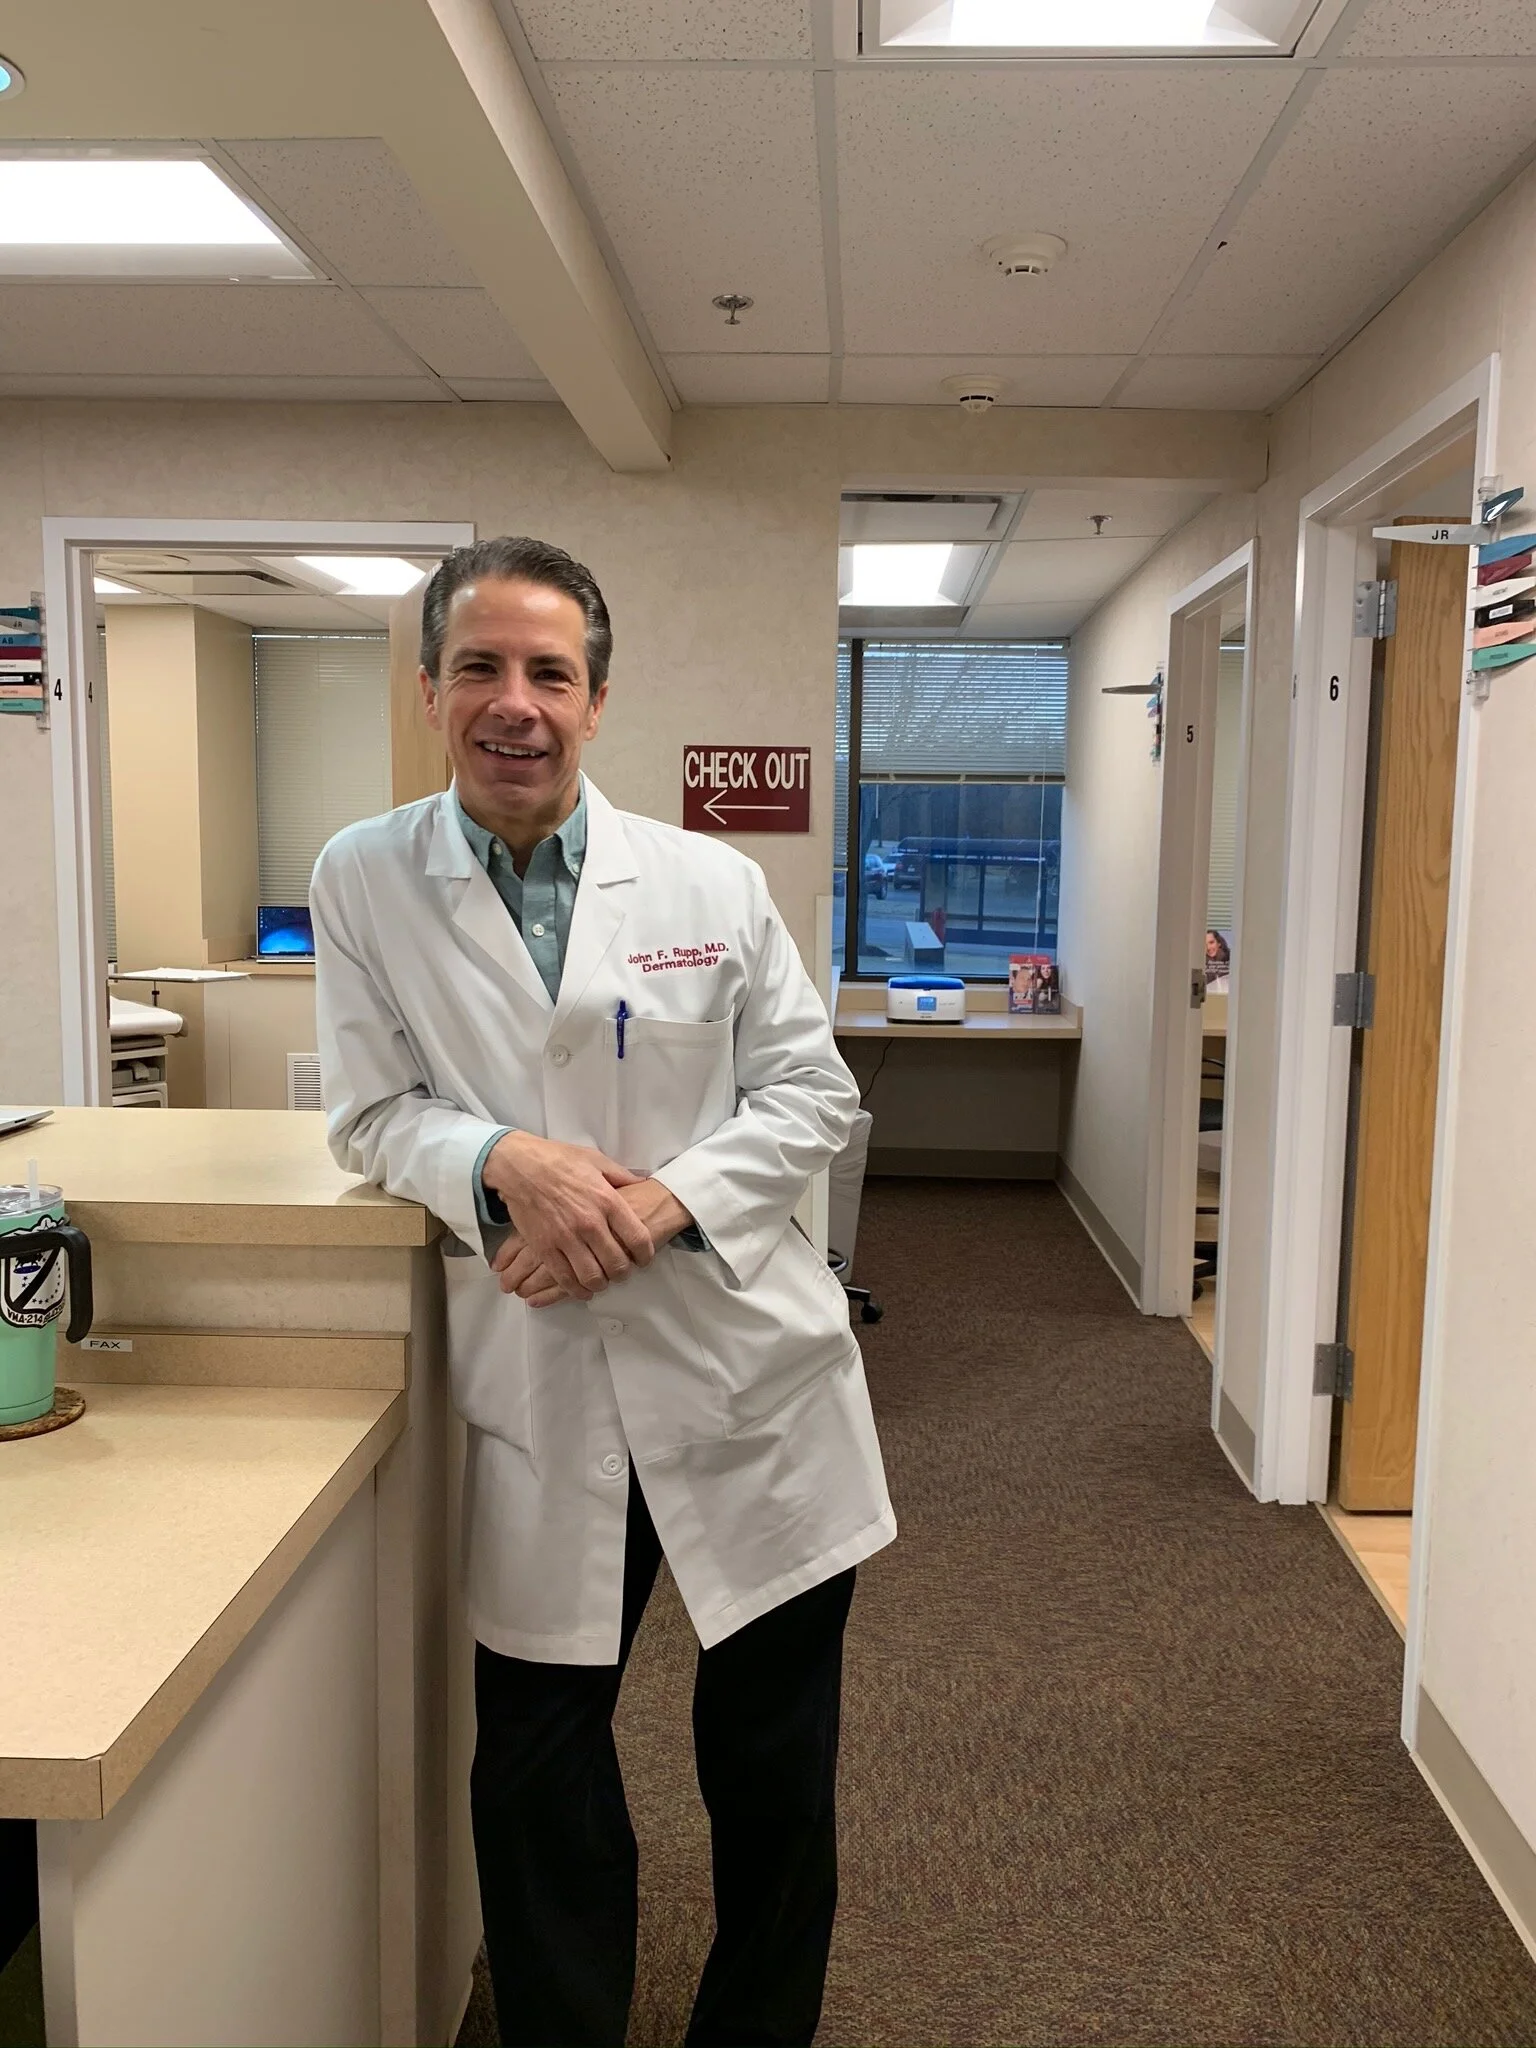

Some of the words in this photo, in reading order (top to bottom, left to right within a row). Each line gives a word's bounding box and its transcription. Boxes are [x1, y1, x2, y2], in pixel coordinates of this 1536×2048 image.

[1431, 529, 1449, 541] JR
[54, 679, 62, 701] 4
[88, 681, 93, 703] 4
[1329, 675, 1340, 701] 6
[1186, 724, 1194, 743] 5
[684, 751, 758, 789] CHECK
[765, 752, 809, 789] OUT
[627, 953, 653, 965] John
[656, 949, 668, 960] F.
[672, 946, 702, 959] Rupp,
[704, 942, 729, 954] M.D.
[641, 955, 719, 973] Dermatology
[90, 1340, 121, 1349] FAX
